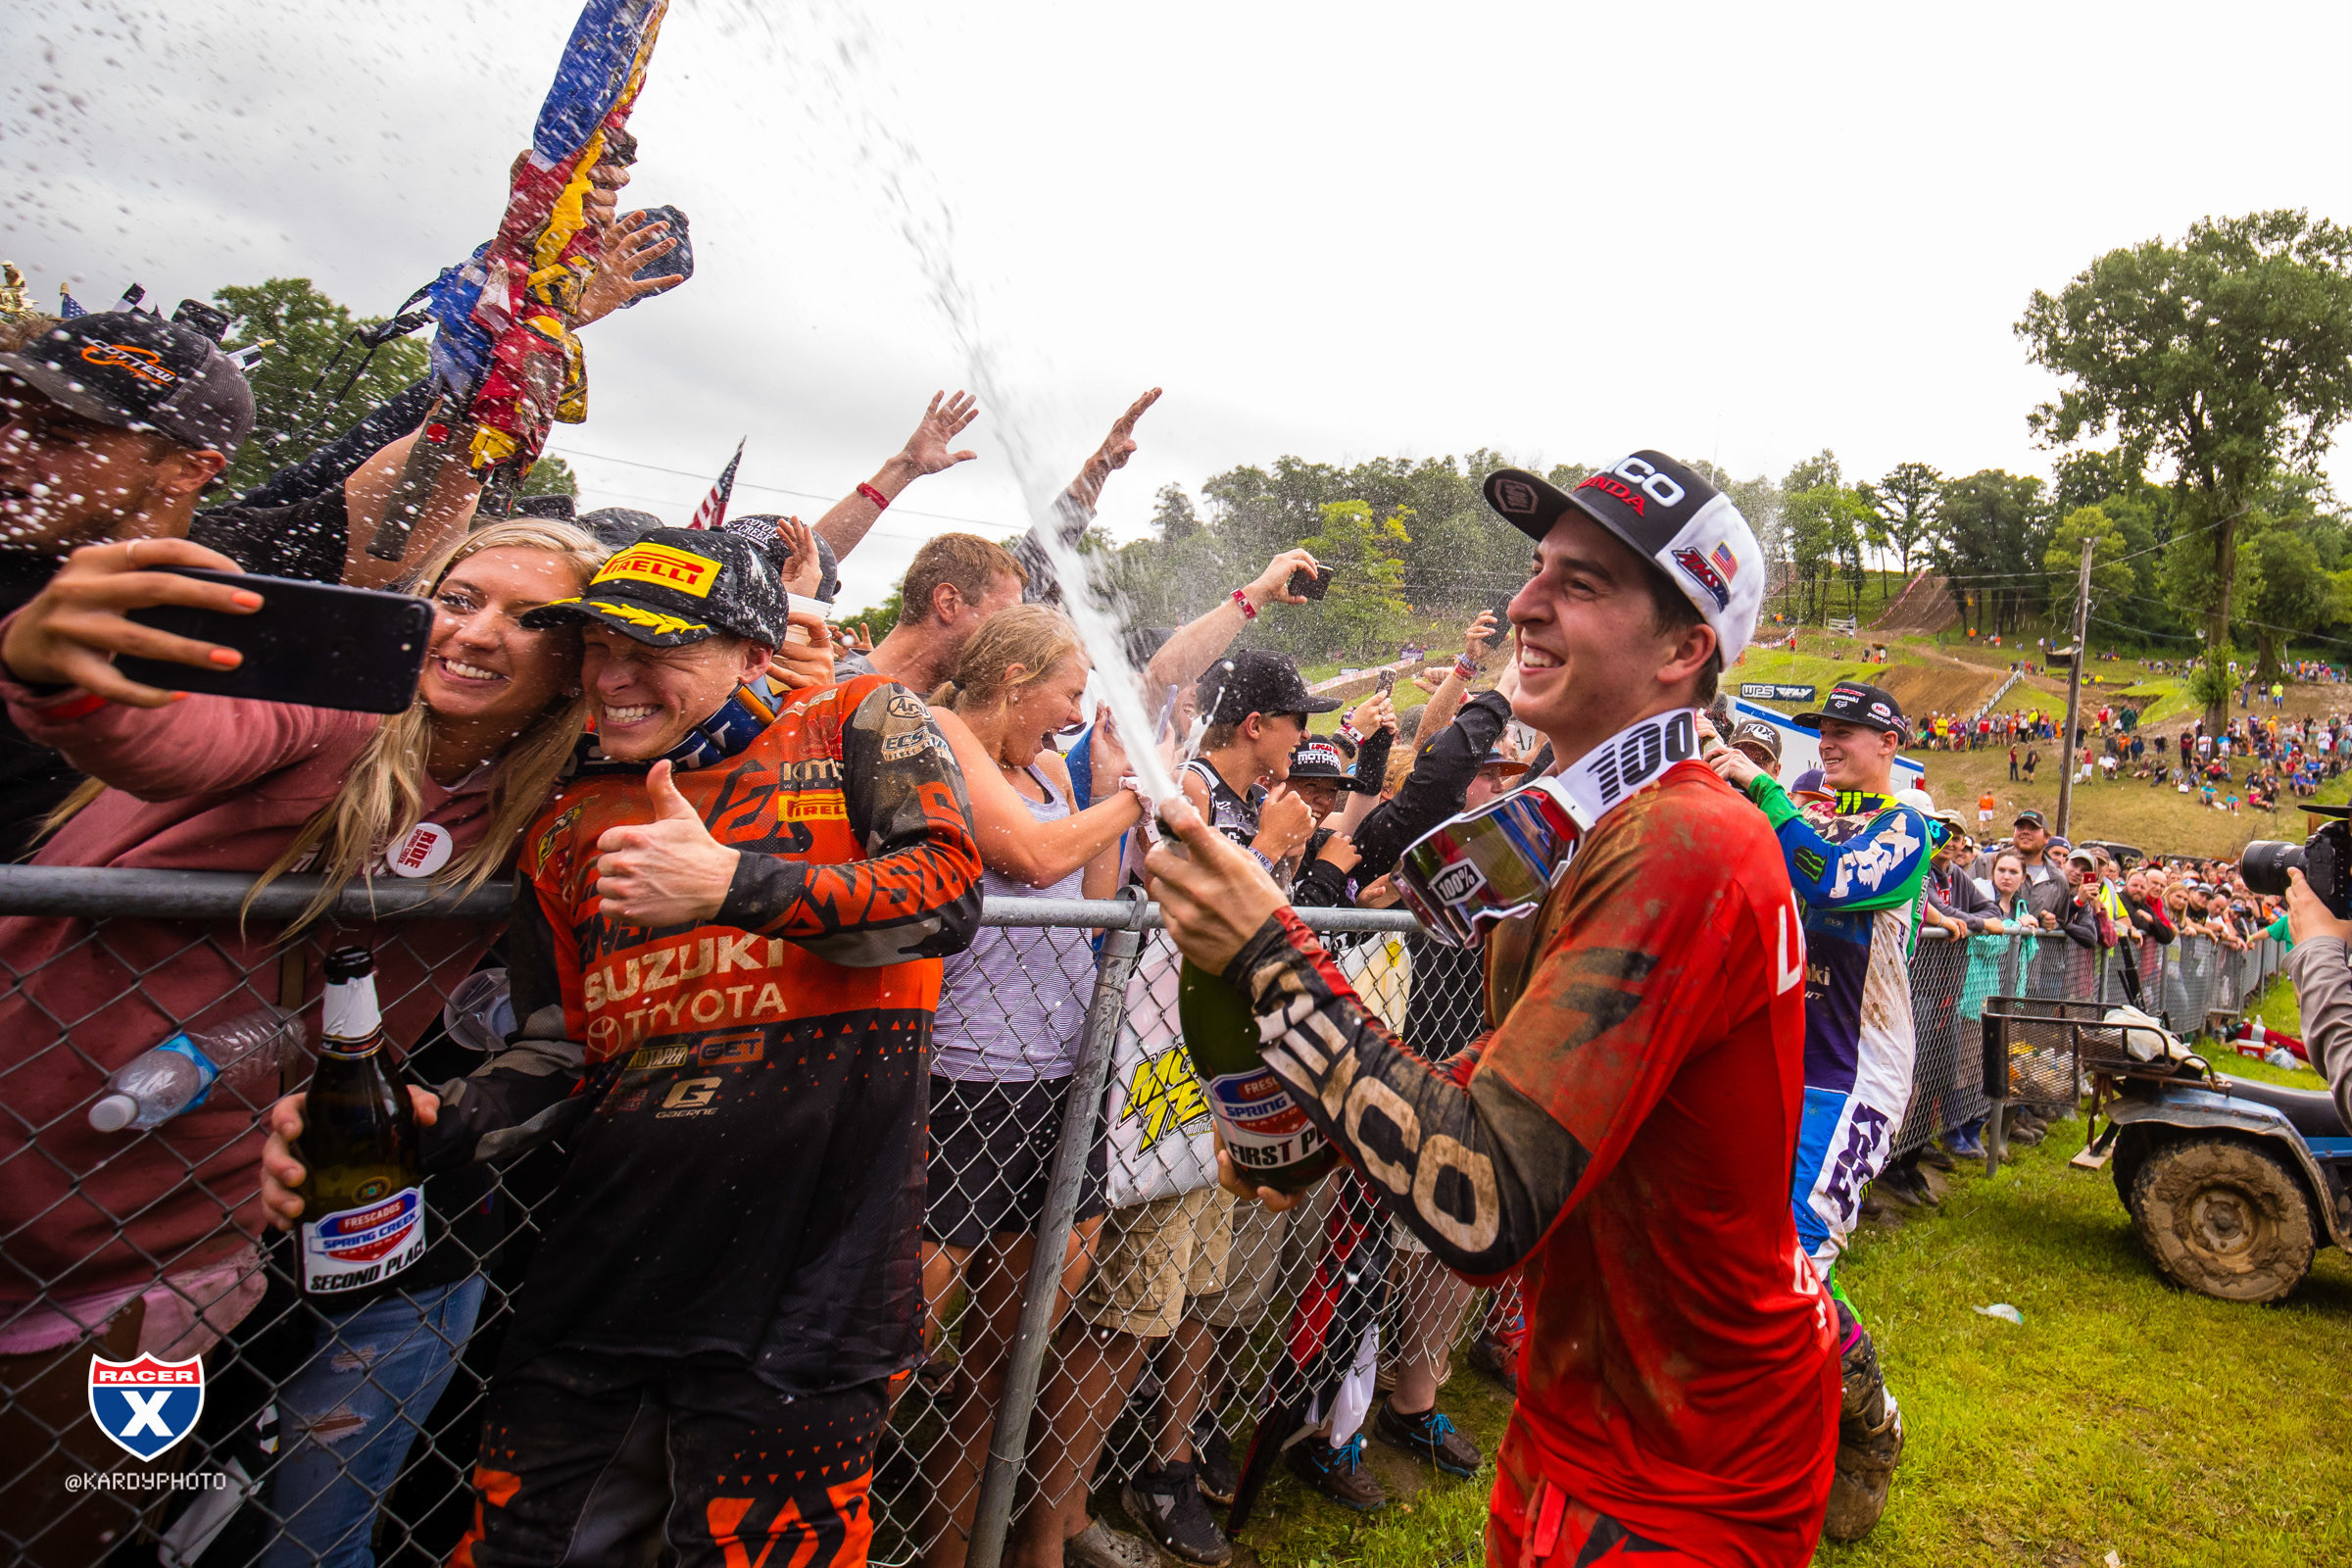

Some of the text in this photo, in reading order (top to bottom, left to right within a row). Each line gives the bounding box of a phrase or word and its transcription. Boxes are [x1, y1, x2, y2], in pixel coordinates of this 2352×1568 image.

[737, 523, 774, 545] CREEK
[601, 551, 705, 586] PIRELLI
[1741, 684, 1775, 699] WPS
[1830, 693, 1860, 704] Kawasaki
[1866, 711, 1891, 725] DUNLOP
[1875, 705, 1888, 714] BELL
[1586, 711, 1694, 807] 100
[404, 831, 438, 869] RIDE
[1438, 865, 1476, 900] 100%
[584, 934, 784, 1013] SUZUKI
[701, 1038, 762, 1060] GET
[1224, 1096, 1289, 1118] SPRING
[1229, 1139, 1294, 1167] FIRST
[344, 1200, 402, 1229] FRESCADOS
[322, 1210, 417, 1250] SPRING CREEK
[310, 1238, 425, 1292] SECOND PLACE
